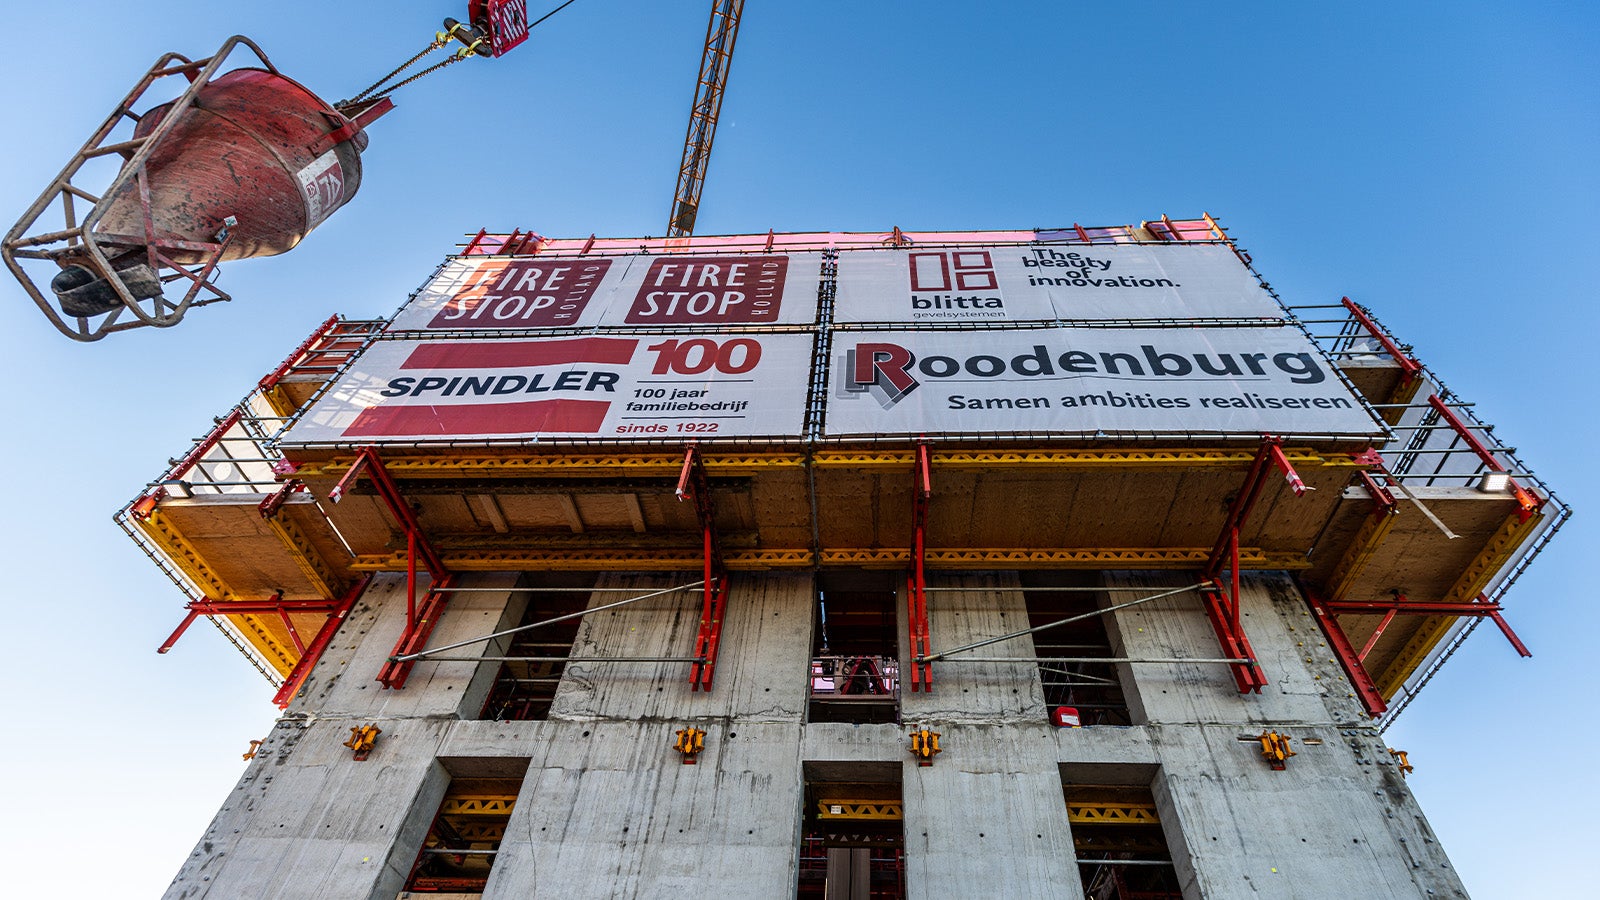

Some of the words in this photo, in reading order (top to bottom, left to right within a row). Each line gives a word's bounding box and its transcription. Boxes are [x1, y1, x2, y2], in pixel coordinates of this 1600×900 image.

[1022, 256, 1112, 271] beauty
[1031, 249, 1081, 260] The
[470, 266, 571, 291] FIRE
[654, 263, 749, 287] FIRE
[1028, 275, 1181, 287] innovation.
[1066, 267, 1092, 279] of
[554, 266, 600, 319] HOLLAND
[751, 262, 779, 315] HOLLAND
[444, 295, 556, 320] STOP
[638, 291, 746, 316] STOP
[911, 295, 1004, 309] blitta
[913, 311, 1006, 319] gevelsystemen
[647, 338, 762, 375] 100
[854, 342, 1325, 391] Roodenburg
[380, 371, 620, 397] SPINDLER
[633, 388, 666, 398] 100
[669, 388, 709, 400] jaar
[948, 395, 1050, 409] Samen
[1061, 391, 1191, 409] ambities
[1199, 392, 1353, 410] realiseren
[626, 401, 749, 412] familiebedrijf
[615, 424, 669, 433] sinds
[676, 423, 719, 432] 1922
